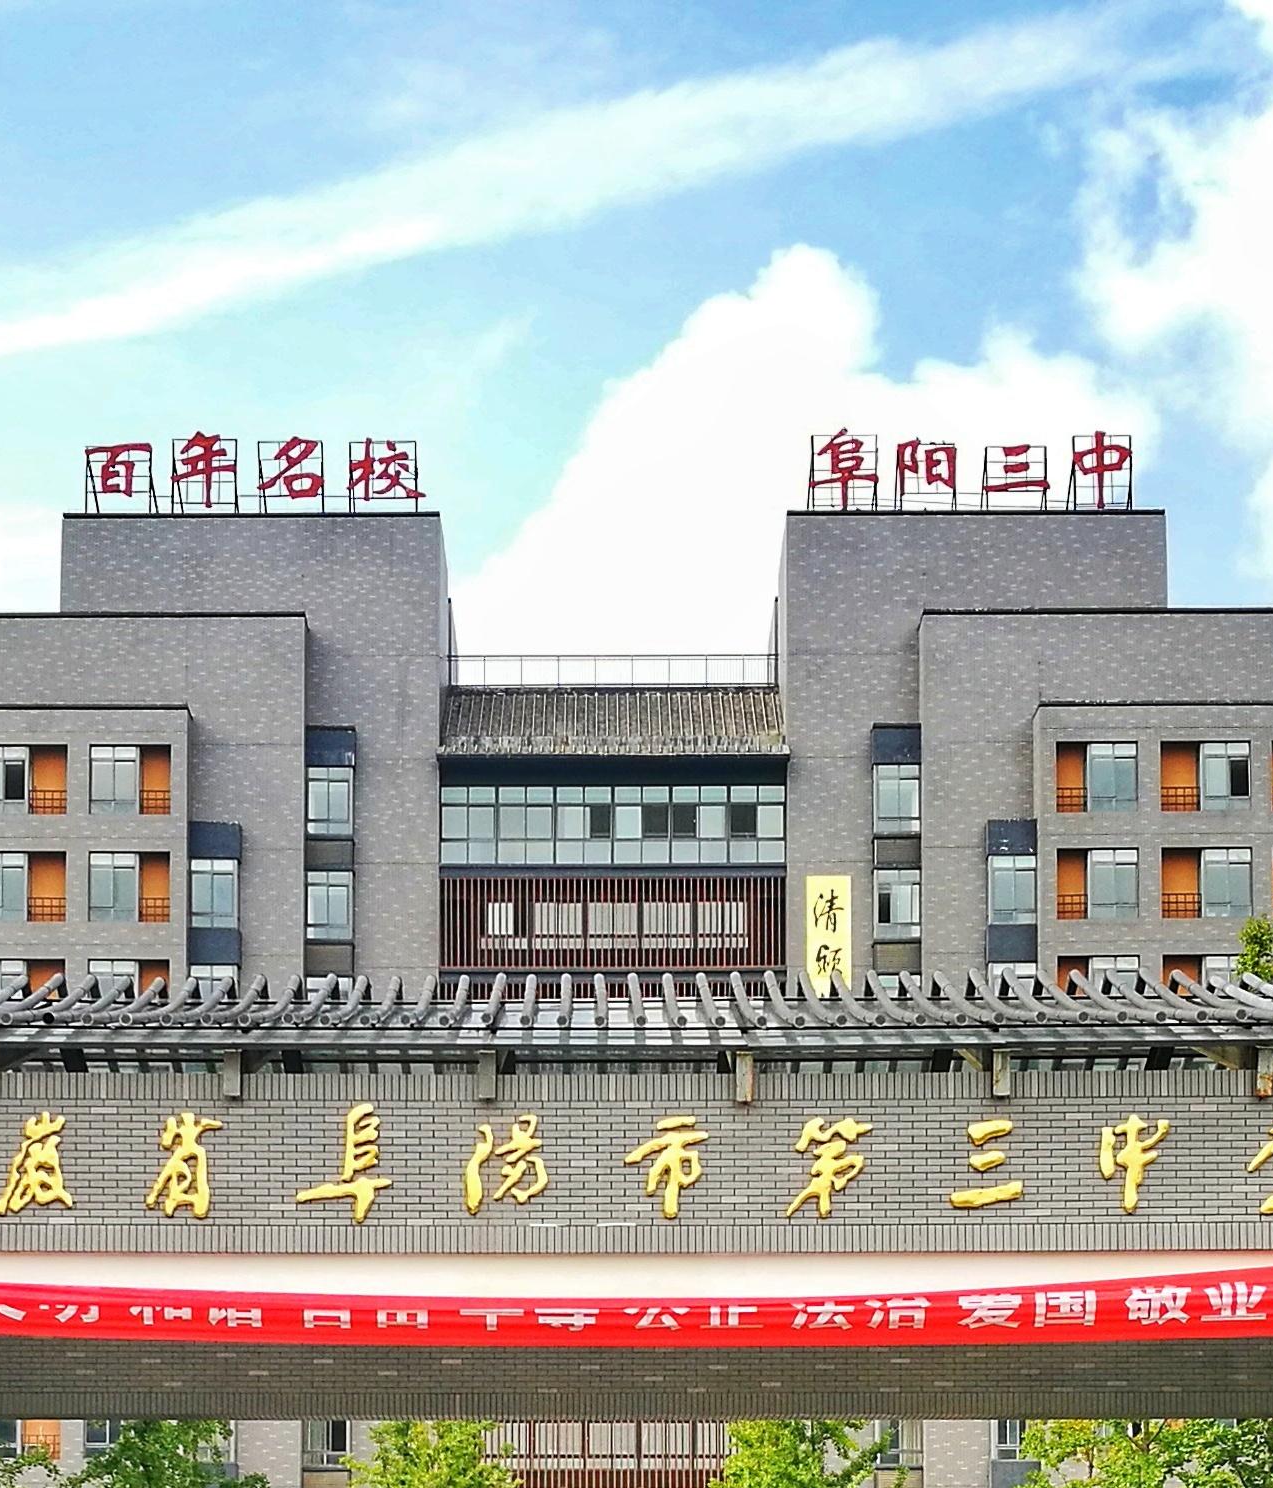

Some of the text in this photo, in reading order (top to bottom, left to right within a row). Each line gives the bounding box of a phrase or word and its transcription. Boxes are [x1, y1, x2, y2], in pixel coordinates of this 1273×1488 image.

[84, 431, 427, 508] 百年名校
[809, 427, 1133, 511] 阜阳三中
[957, 1289, 1098, 1329] 爱国
[1124, 1281, 1268, 1325] 敬业
